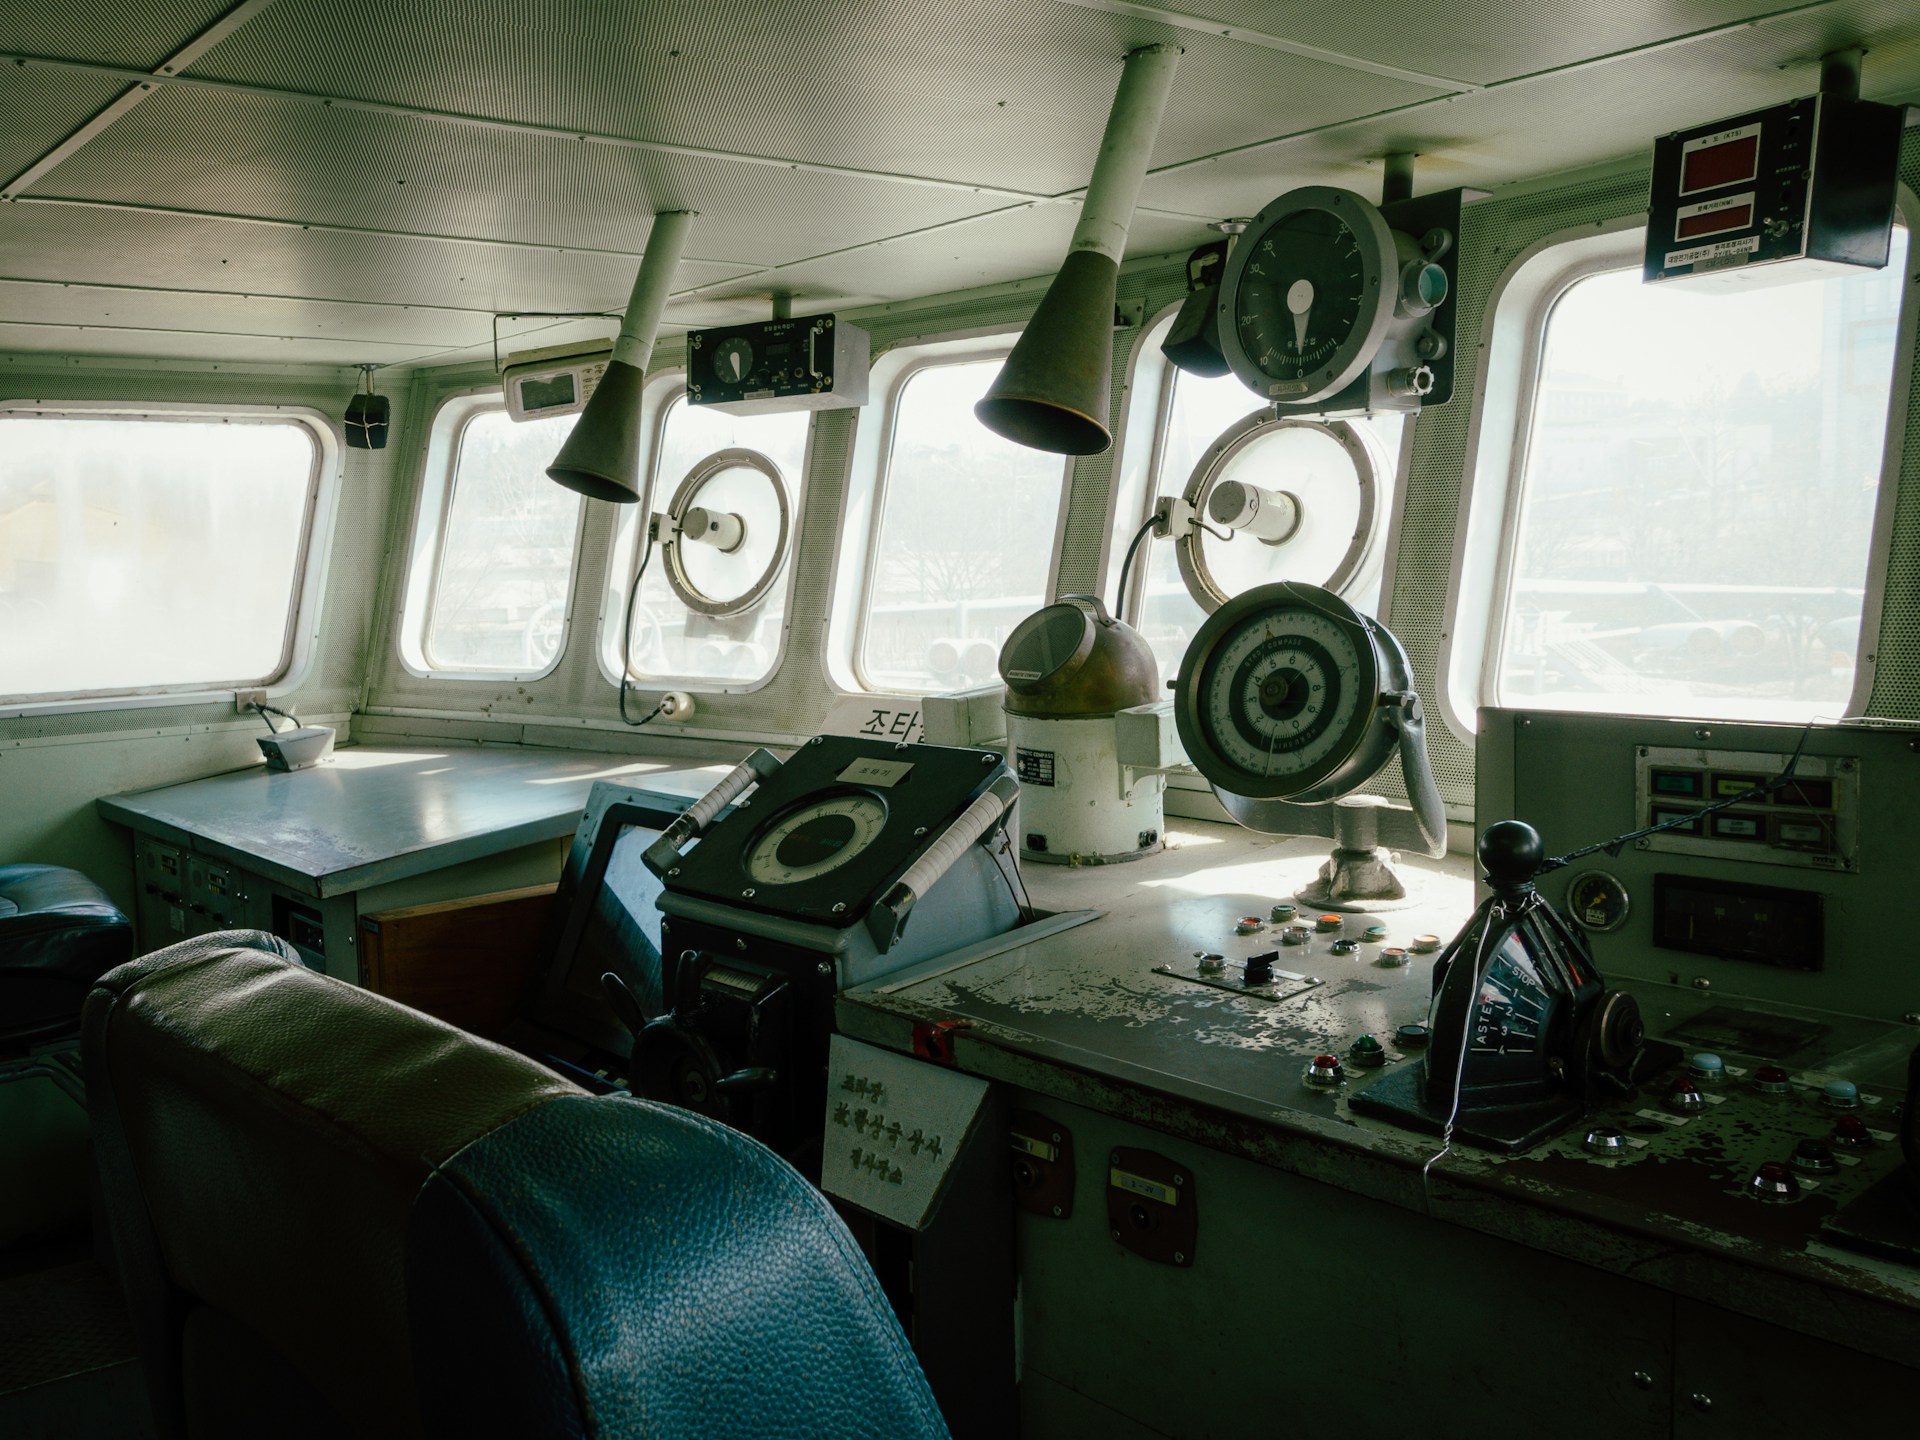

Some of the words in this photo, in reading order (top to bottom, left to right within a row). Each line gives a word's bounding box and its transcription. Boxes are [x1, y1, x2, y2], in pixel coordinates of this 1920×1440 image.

[1262, 240, 1273, 251] 35
[1249, 263, 1260, 274] 30
[1241, 316, 1251, 327] 20
[1259, 356, 1269, 367] 10
[1297, 368, 1303, 379] 0
[1269, 659, 1277, 669] 5
[1289, 655, 1296, 665] 6
[1305, 664, 1314, 673] 7
[1312, 684, 1321, 692] 8
[1248, 695, 1257, 703] 3
[858, 767, 892, 777] 조타기
[1812, 855, 1837, 864] mtu
[1511, 965, 1536, 988] STOP
[1510, 988, 1518, 998] 1
[1505, 1006, 1514, 1017] 2
[1500, 1025, 1509, 1037] 3
[1498, 1045, 1505, 1056] 4
[841, 1074, 884, 1105] 조타장
[854, 1108, 904, 1149] 한상국
[907, 1129, 943, 1163] 상사
